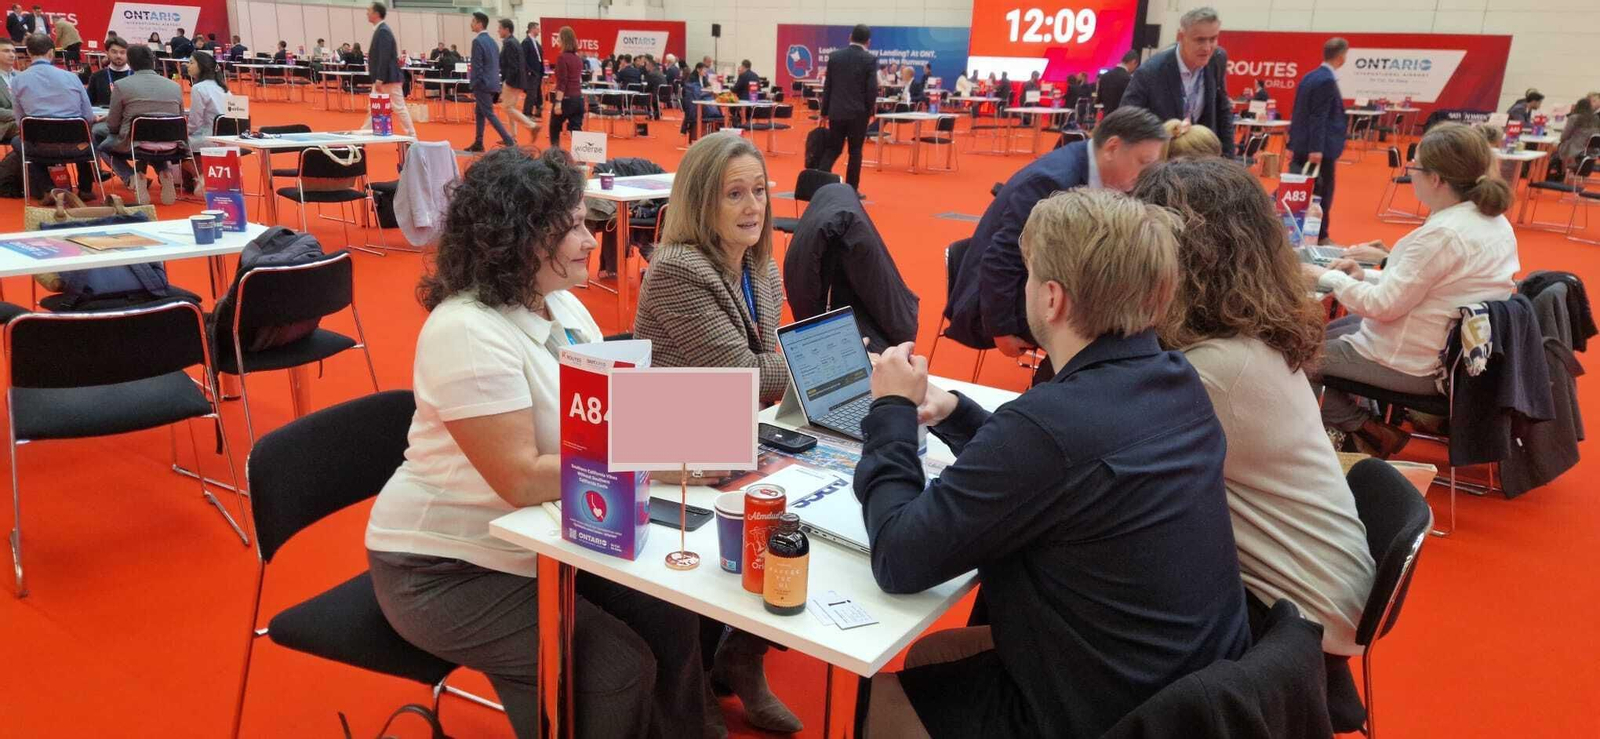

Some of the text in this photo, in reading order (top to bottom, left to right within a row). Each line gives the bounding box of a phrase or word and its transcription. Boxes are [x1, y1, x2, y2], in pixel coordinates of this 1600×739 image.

[123, 10, 181, 21] ONTARIO
[1005, 7, 1097, 44] 12:09
[622, 36, 656, 46] ONTARIO
[1226, 60, 1298, 78] ROUTES
[1355, 58, 1432, 71] ONTARIO
[1264, 80, 1296, 89] ORLD
[207, 165, 231, 179] A71
[1284, 190, 1307, 202] A83
[578, 532, 607, 547] ONTARIO
